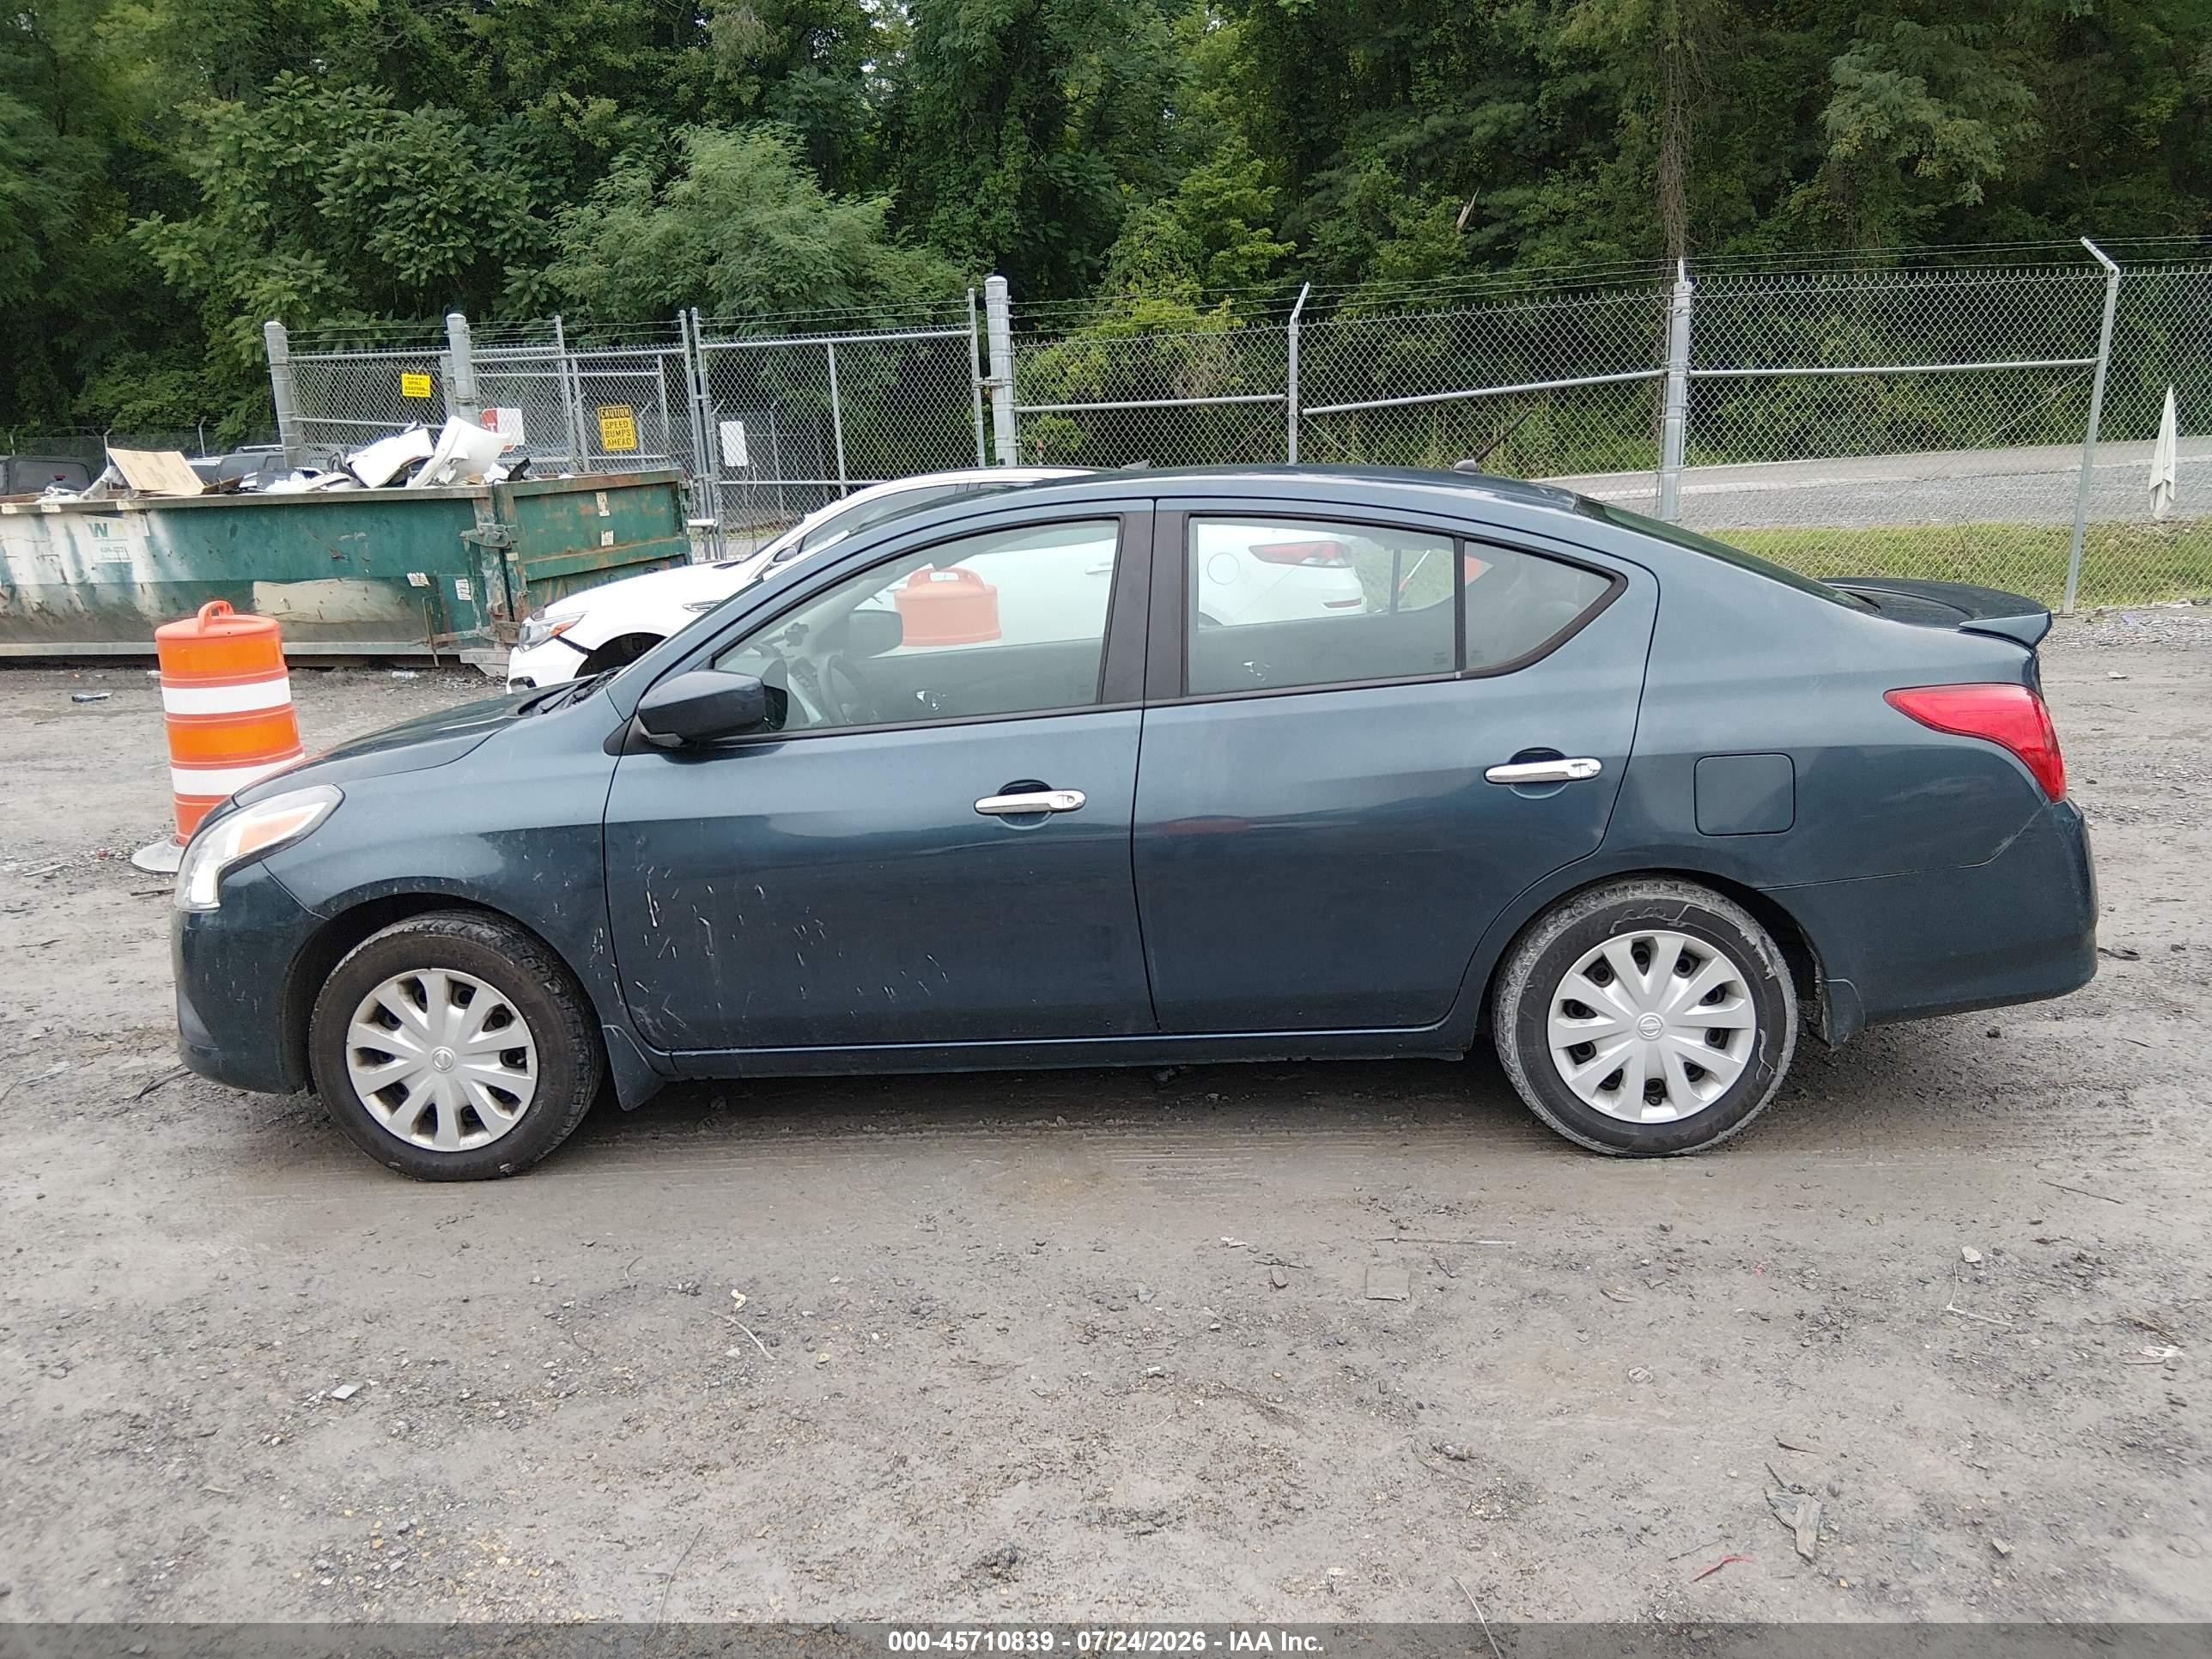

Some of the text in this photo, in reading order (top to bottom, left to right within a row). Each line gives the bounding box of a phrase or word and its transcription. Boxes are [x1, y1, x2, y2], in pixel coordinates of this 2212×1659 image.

[601, 408, 630, 418] CAUTION
[605, 421, 629, 429] SPEED
[605, 429, 631, 438] BUMPS
[607, 438, 631, 447] AHEAD
